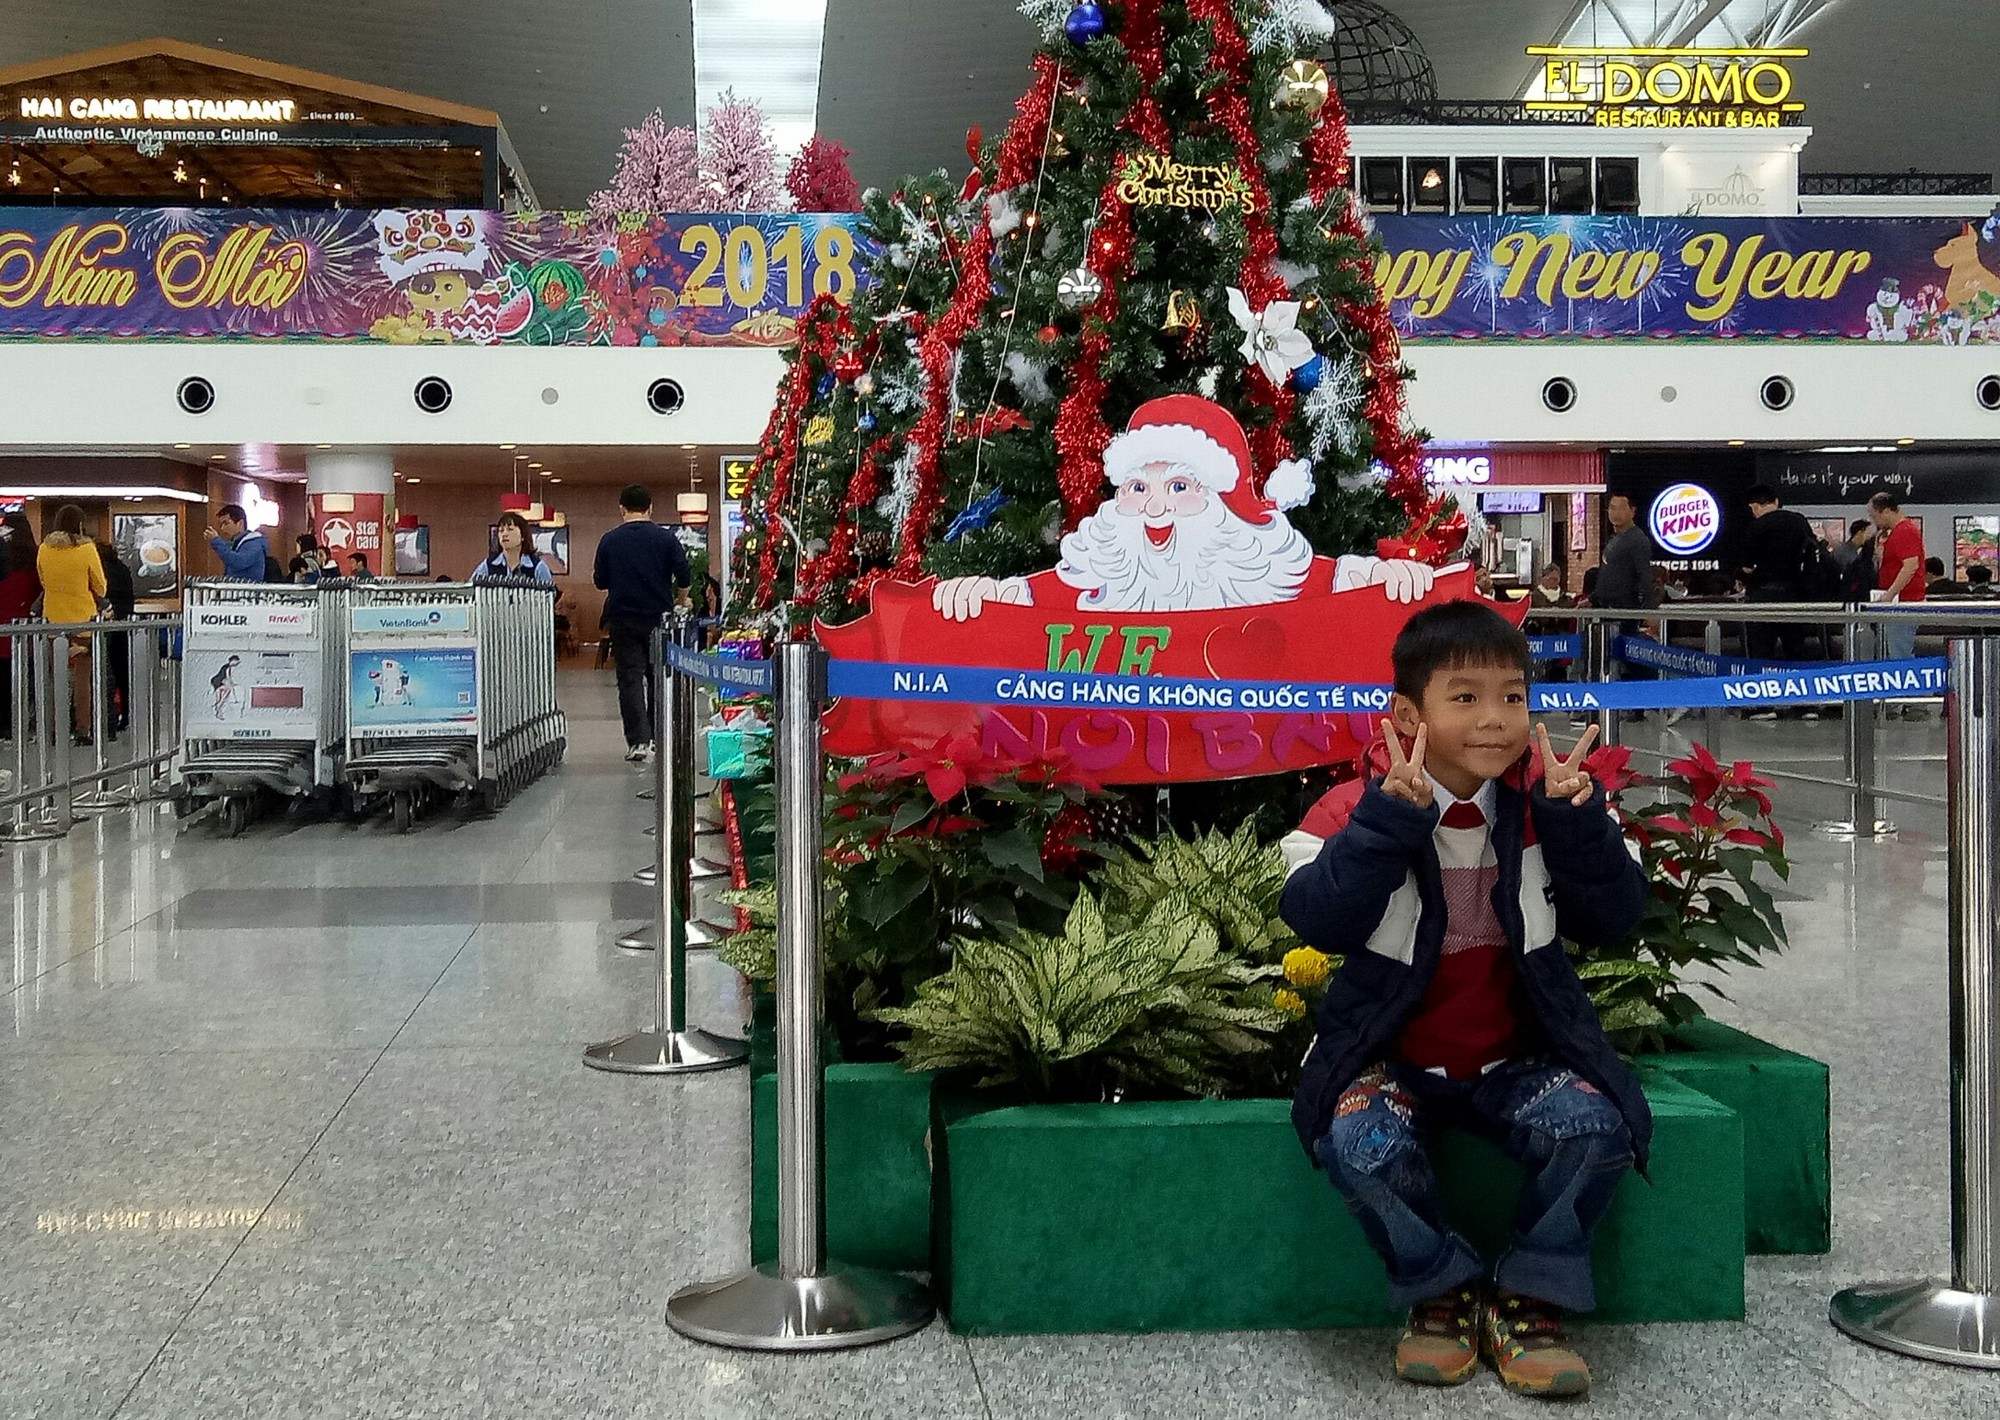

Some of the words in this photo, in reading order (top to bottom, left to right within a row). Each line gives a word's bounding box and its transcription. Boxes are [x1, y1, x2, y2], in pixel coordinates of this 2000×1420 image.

[1546, 61, 1589, 93] EL
[1602, 61, 1792, 105] DOMO
[20, 97, 63, 118] HAI
[69, 98, 138, 119] CANG
[143, 98, 295, 120] RESTAURANT
[35, 127, 114, 140] Authentic
[220, 128, 279, 142] Cuisine
[1144, 154, 1230, 188] Merry
[1116, 179, 1255, 214] Christmas
[1706, 193, 1760, 206] DOMO
[0, 221, 137, 308] Năm
[679, 224, 856, 308] 2018
[1491, 231, 1660, 307] New
[1681, 232, 1872, 322] Year
[1838, 473, 1879, 497] your
[1883, 472, 1914, 497] way
[1660, 499, 1710, 520] BURGER
[1662, 511, 1711, 537] KING
[200, 614, 248, 626] KOHLER
[1044, 622, 1173, 677] WE
[892, 671, 950, 694] N.I.A
[995, 673, 1065, 700] CẢNG
[1072, 680, 1140, 705] HÀNG
[1148, 683, 1233, 708] KHÔNG
[1239, 685, 1310, 709] QUỐC
[1316, 686, 1346, 708] TẾ
[1540, 692, 1600, 709] N.I.A
[1723, 675, 1808, 701] NOIBAI
[1813, 666, 1948, 696] INTERNATI
